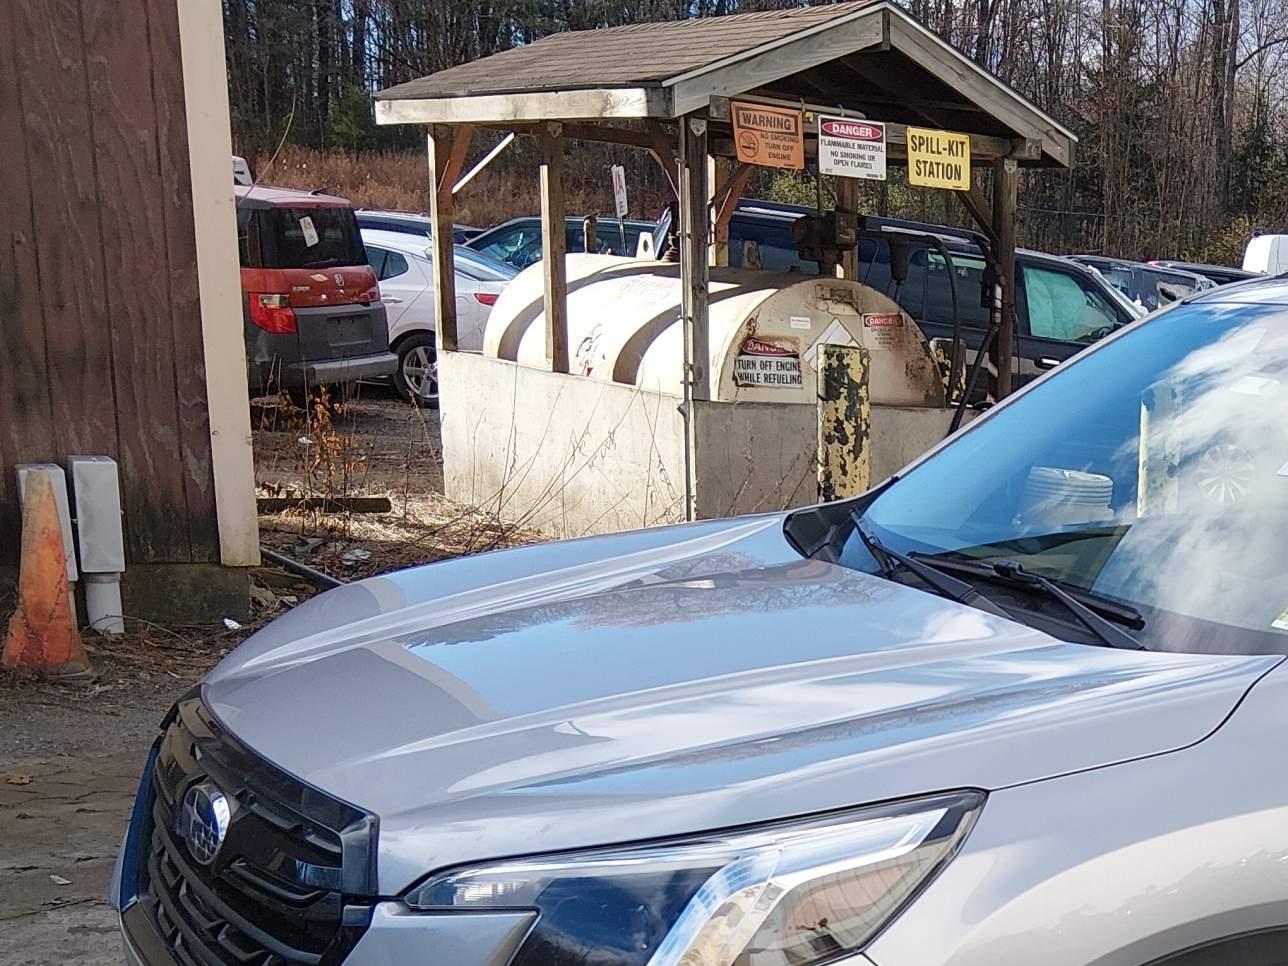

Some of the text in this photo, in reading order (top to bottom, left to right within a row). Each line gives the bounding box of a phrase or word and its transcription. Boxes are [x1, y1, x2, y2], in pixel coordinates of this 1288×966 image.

[743, 112, 791, 129] WARNING
[832, 123, 873, 137] DANGER
[760, 132, 799, 143] NO SMOKING
[765, 143, 794, 152] TURN OFF
[820, 139, 884, 153] FLAMMABLE MATERIAL
[911, 135, 965, 157] SPILL-KIT
[768, 152, 791, 161] ENGINE
[830, 150, 839, 158] NO
[840, 152, 866, 161] SMOKING
[833, 159, 873, 170] OPEN FLAMES
[916, 159, 961, 180] STATION
[738, 359, 801, 372] TURN OFF ENGINE
[737, 372, 802, 385] WHILE REFUELING
